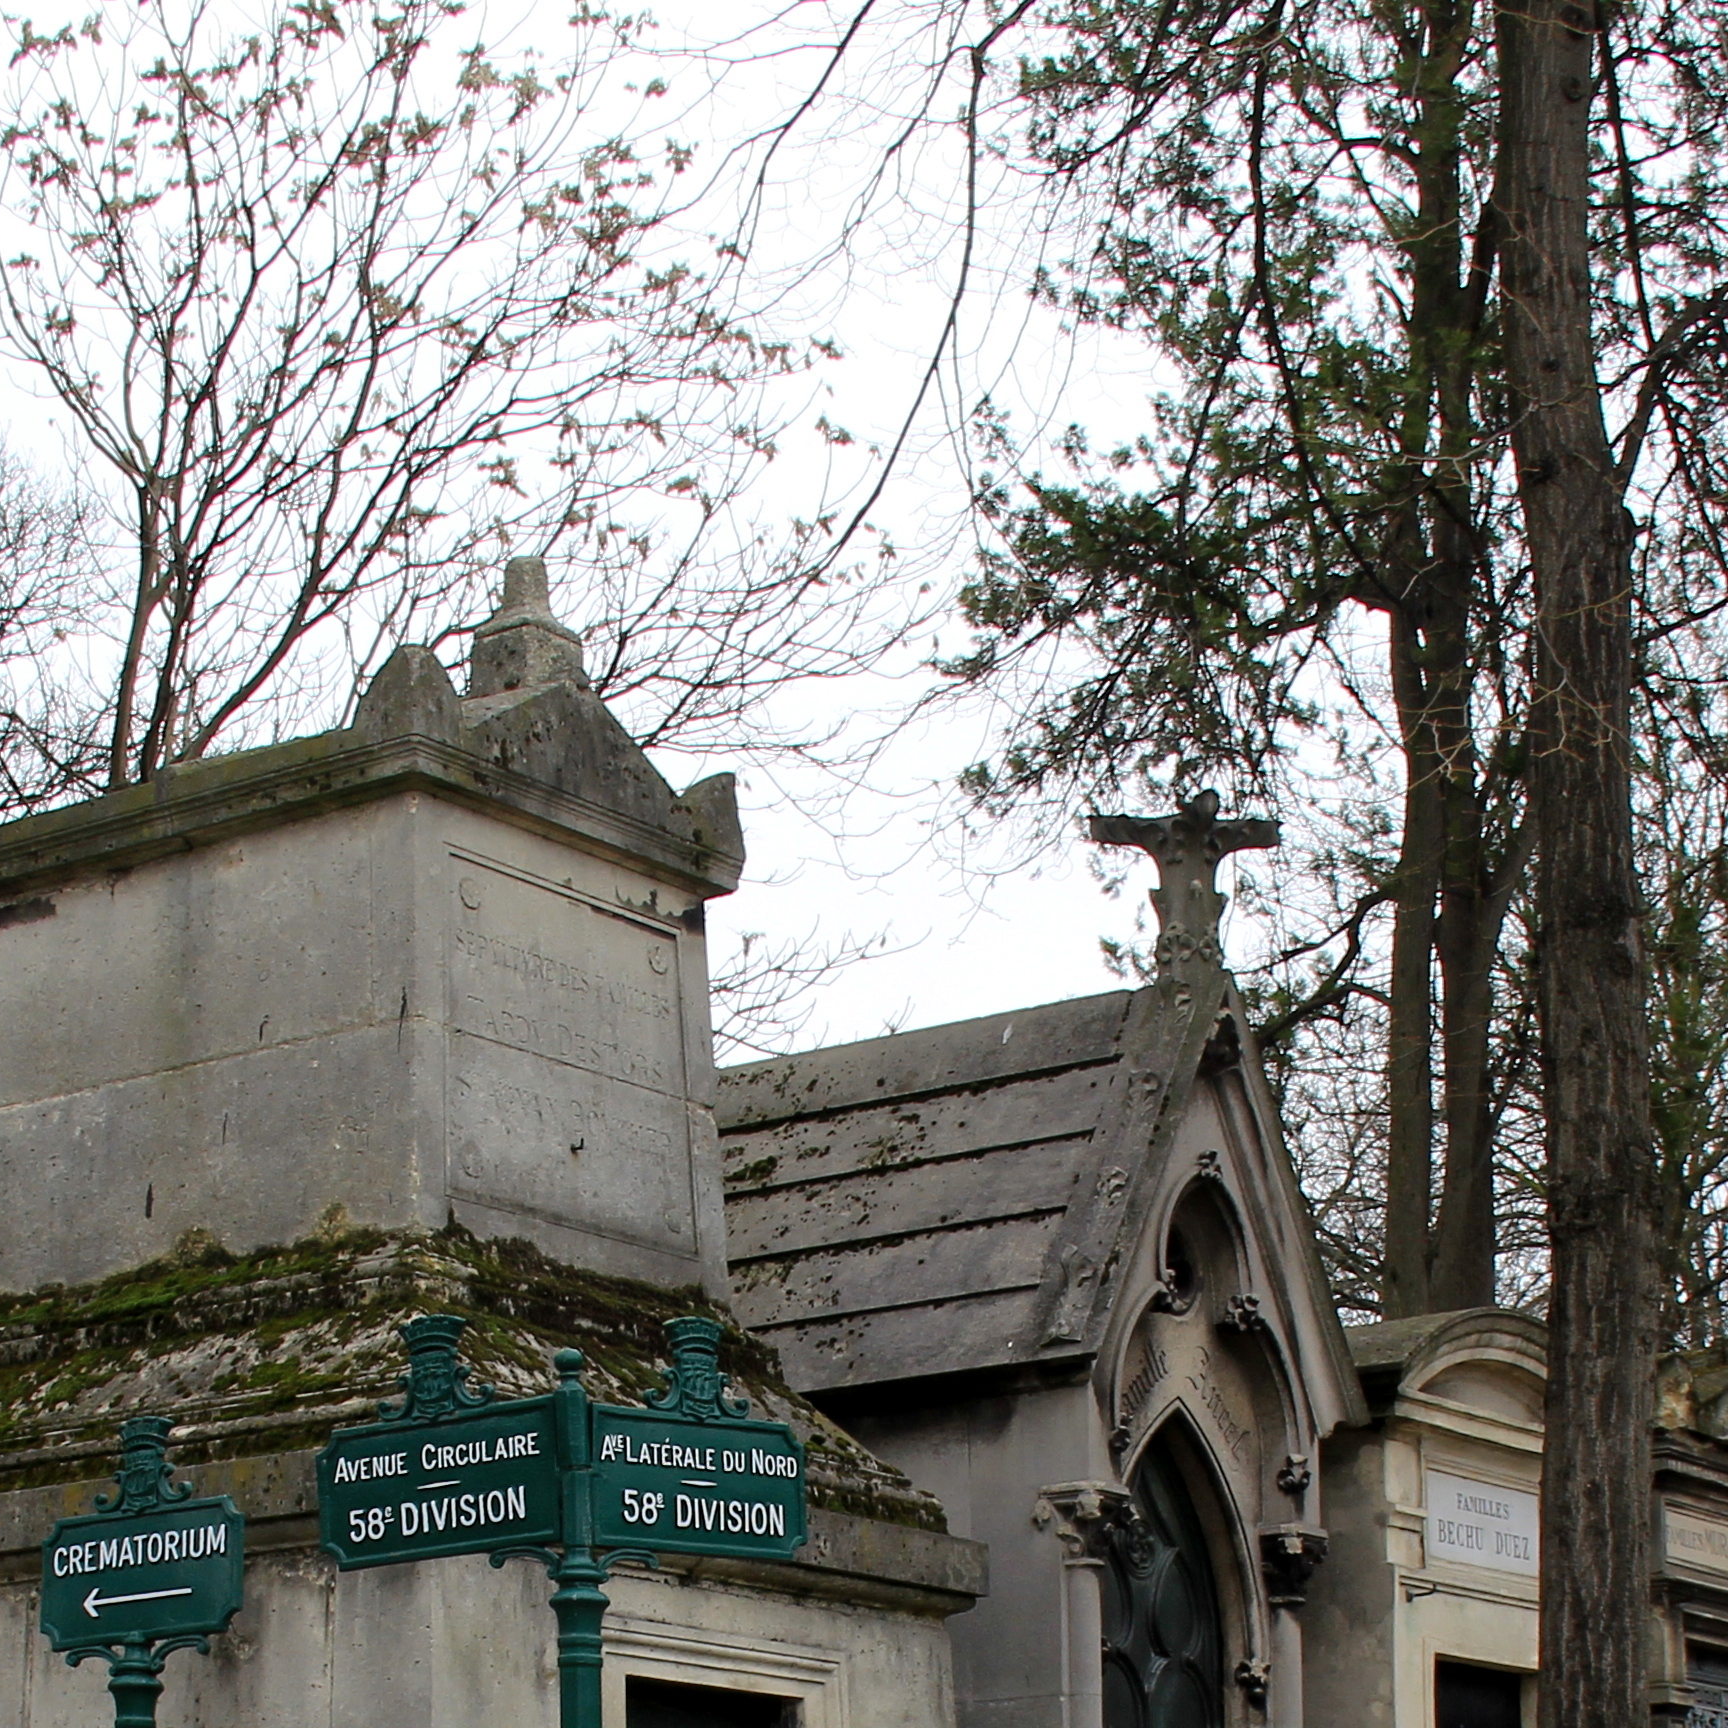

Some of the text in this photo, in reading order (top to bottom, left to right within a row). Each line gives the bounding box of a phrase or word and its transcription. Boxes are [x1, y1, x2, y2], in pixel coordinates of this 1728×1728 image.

[1121, 1338, 1169, 1413] amille
[334, 1432, 541, 1484] AVENUE CIRCULAIRE
[625, 1436, 717, 1471] LATÉRALE
[723, 1449, 746, 1473] DU
[751, 1448, 798, 1479] NORD
[400, 1485, 527, 1537] DIVISION
[676, 1494, 786, 1537] DIVISION
[1456, 1492, 1511, 1520] FAMILLES
[52, 1522, 228, 1579] CREMATORIUM
[1438, 1518, 1531, 1561] BECHU DUEZ
